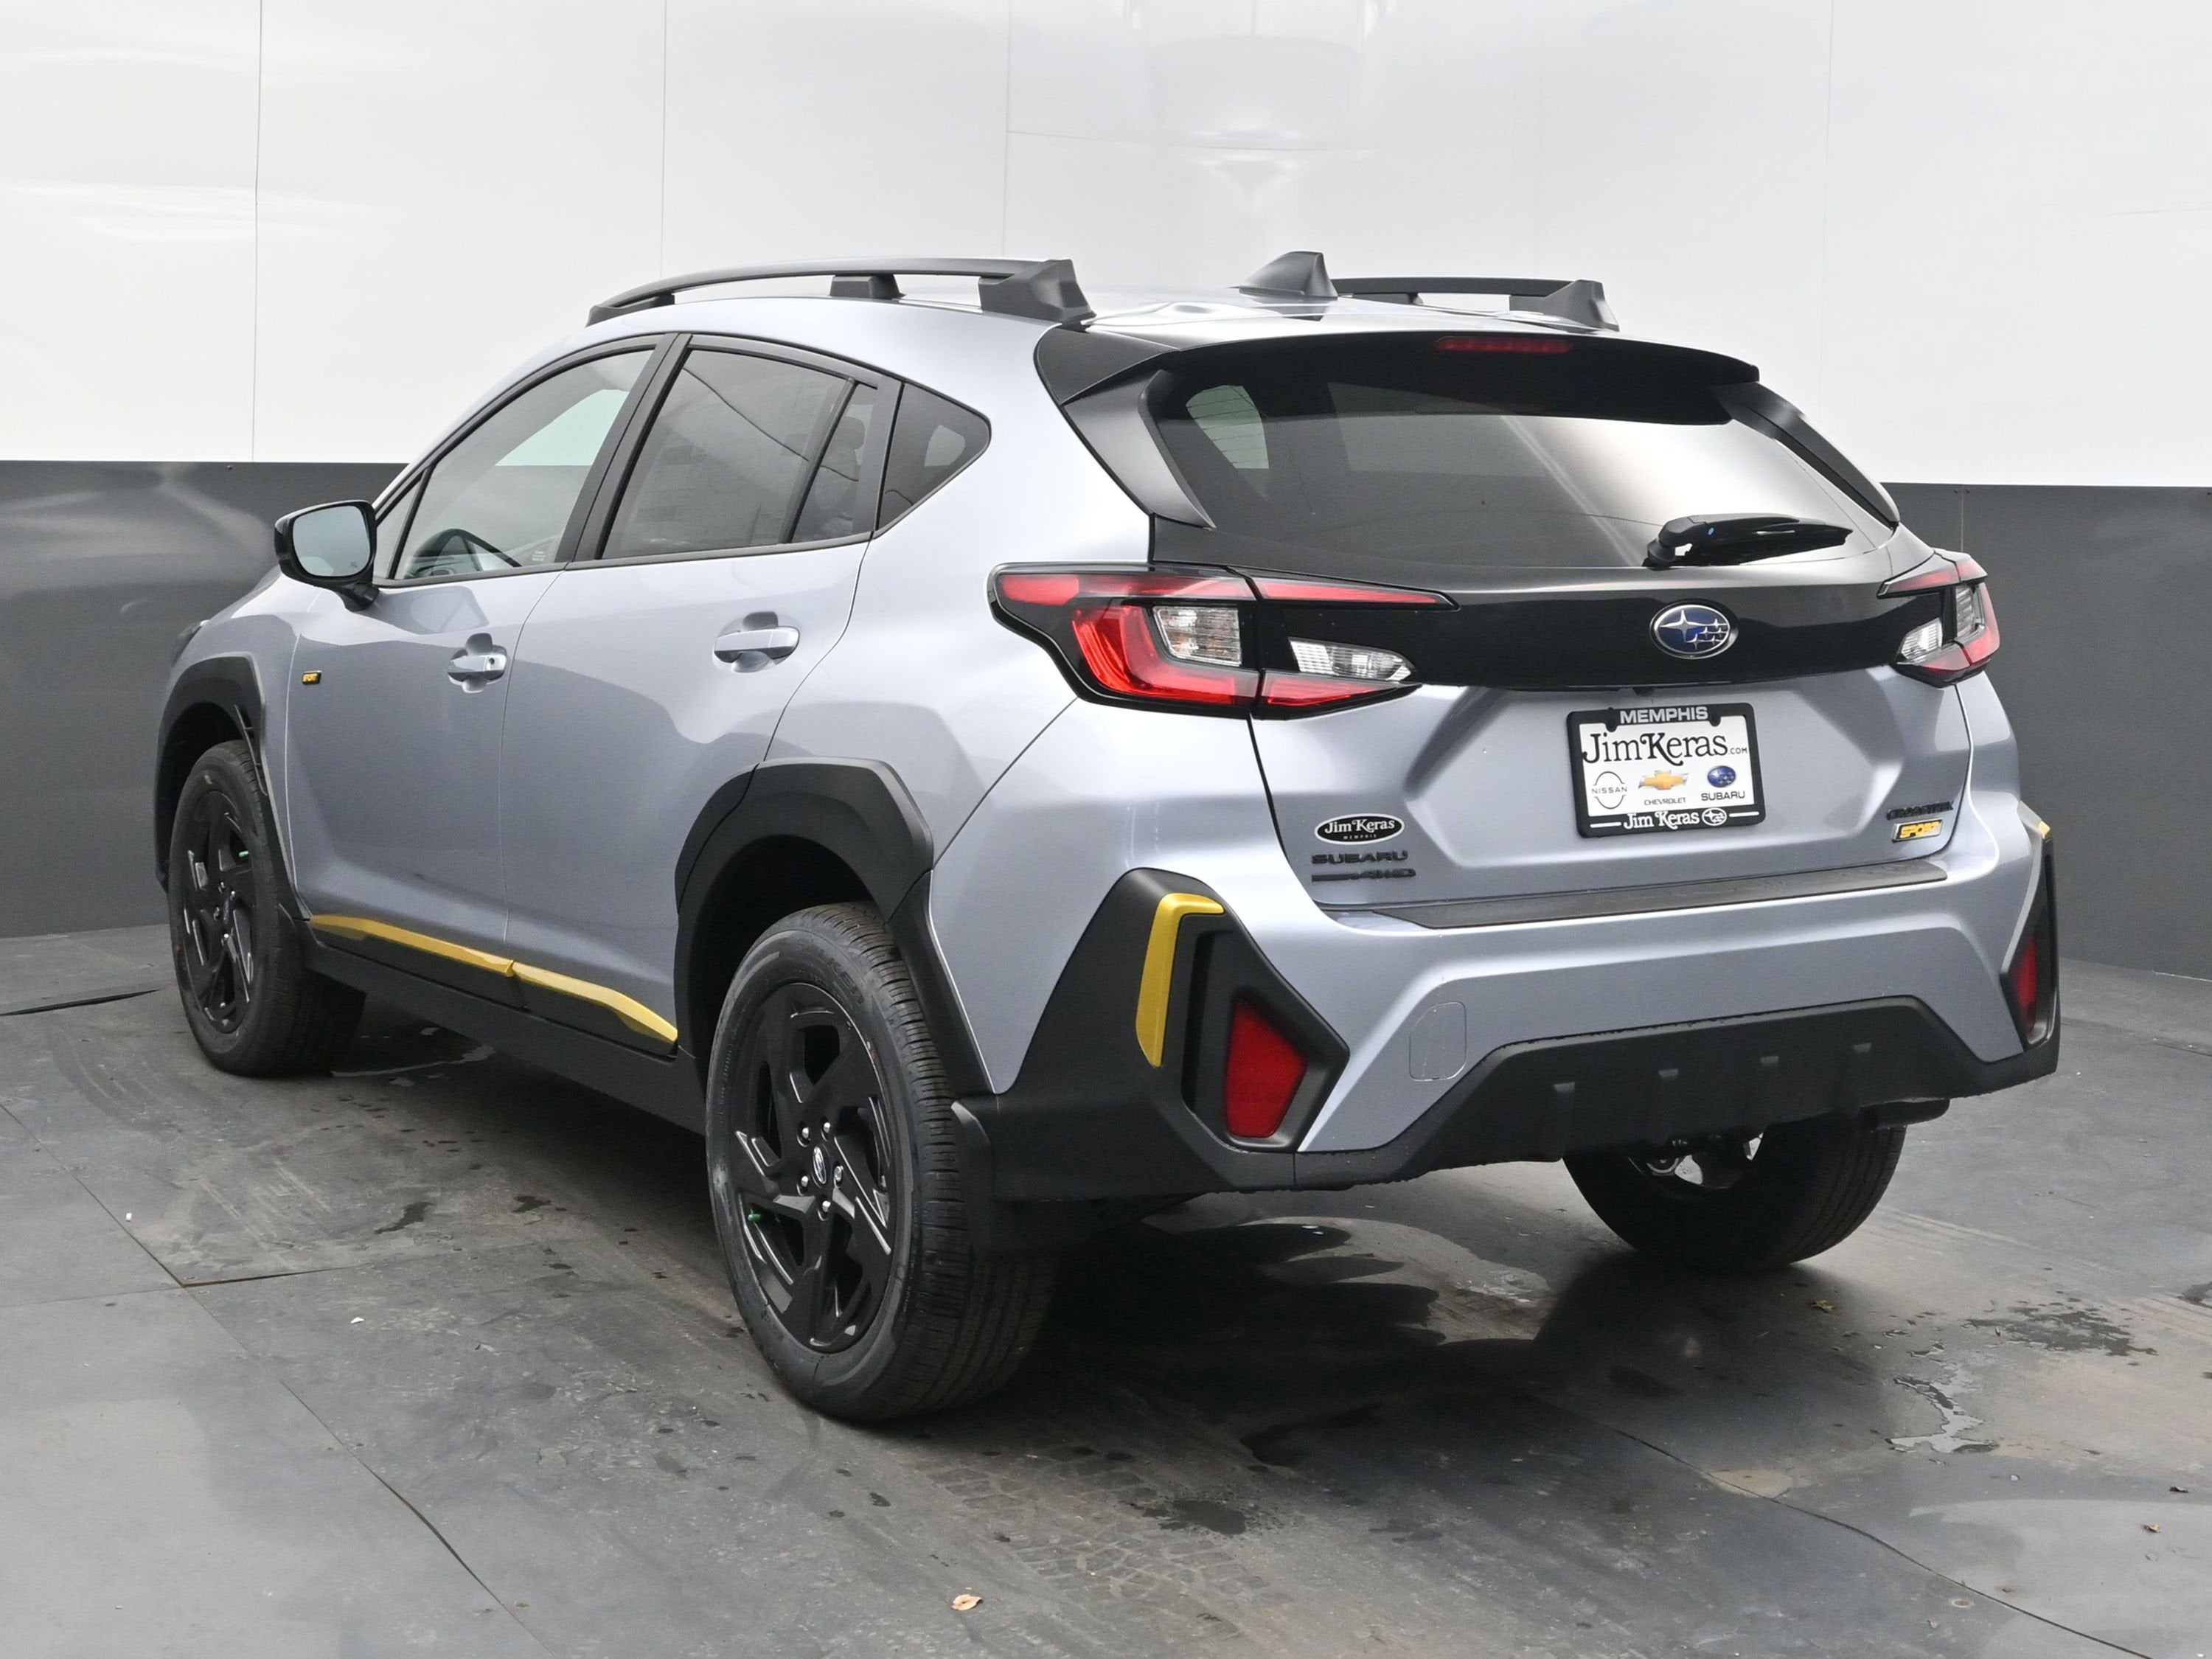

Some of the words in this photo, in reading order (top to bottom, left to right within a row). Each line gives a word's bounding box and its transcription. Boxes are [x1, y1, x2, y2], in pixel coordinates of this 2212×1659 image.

[1620, 706, 1708, 725] MEMPHIS
[1644, 797, 1686, 806] CHEVROLET
[1701, 790, 1746, 801] SUBARU
[1324, 821, 1352, 834] Jim
[1352, 818, 1396, 833] Keras
[1623, 812, 1654, 830] Jim
[1655, 810, 1700, 830] Keras
[1312, 850, 1408, 864] SUBARU
